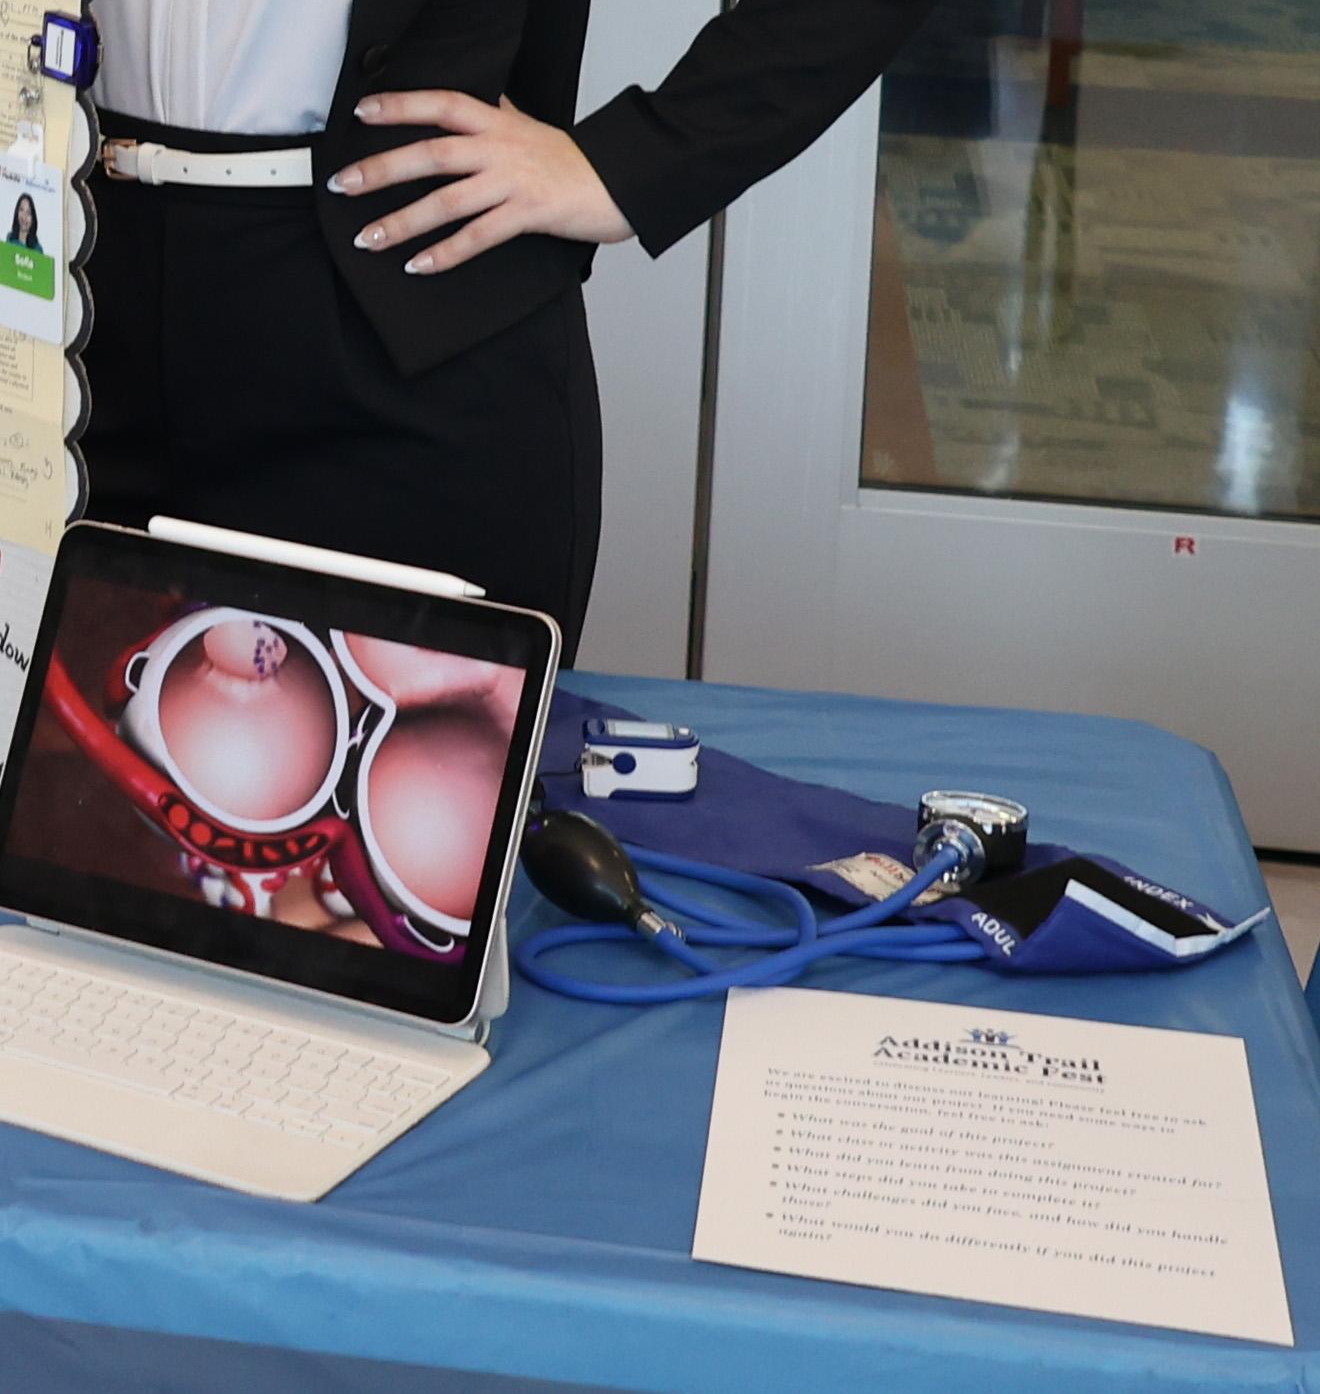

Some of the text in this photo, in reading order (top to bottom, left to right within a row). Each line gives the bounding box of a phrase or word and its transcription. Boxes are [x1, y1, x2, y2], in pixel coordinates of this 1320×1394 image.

[1123, 875, 1194, 910] INDEX
[873, 1047, 1106, 1085] Academic Fest
[879, 1035, 1101, 1072] Addison Trail
